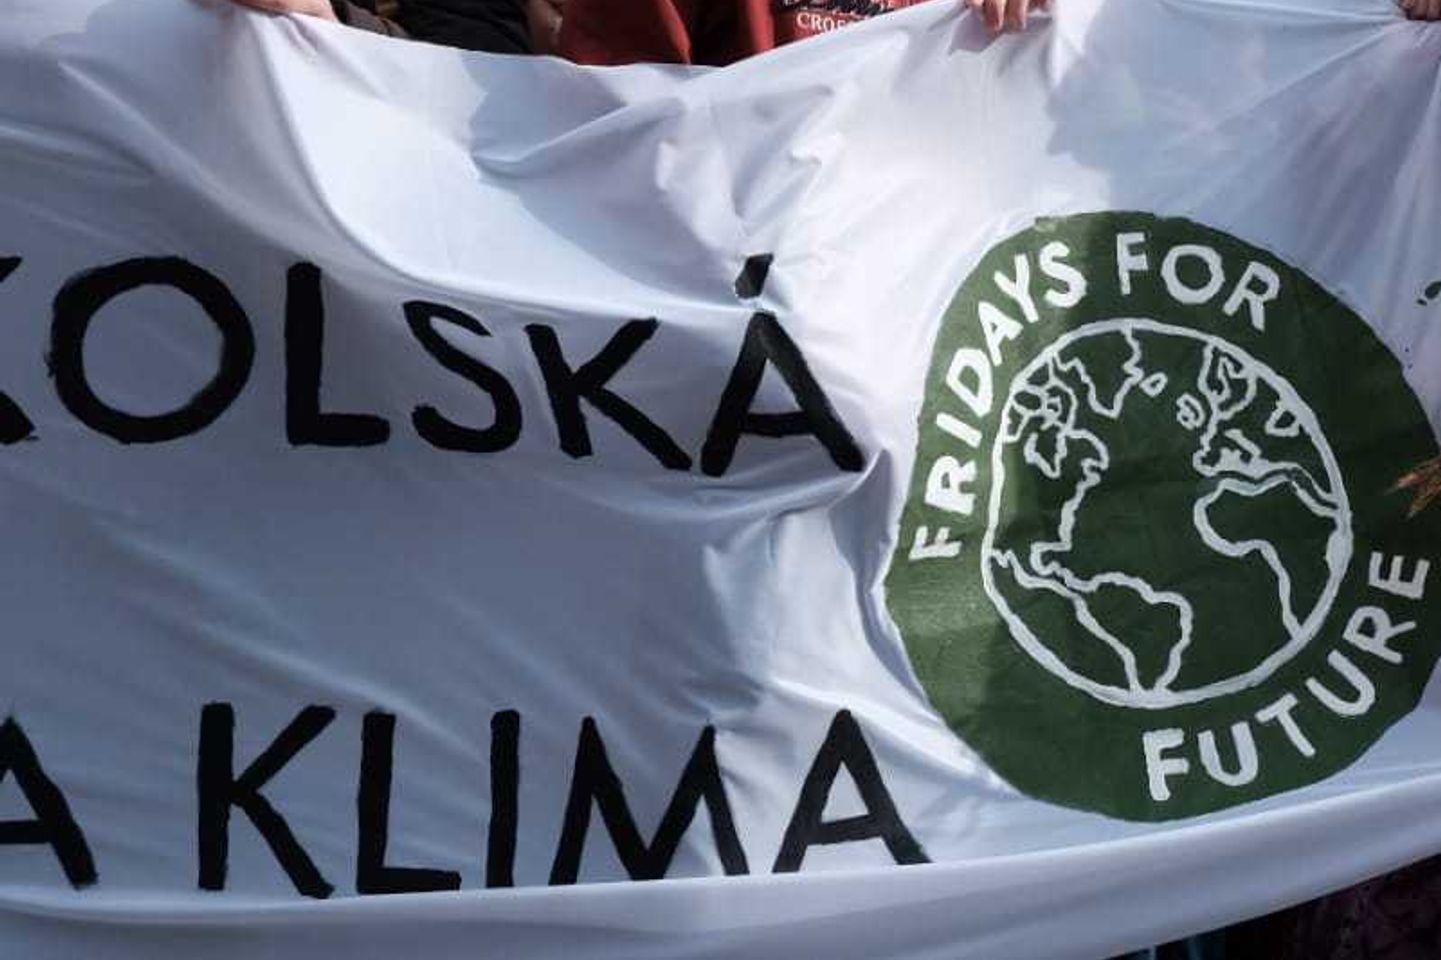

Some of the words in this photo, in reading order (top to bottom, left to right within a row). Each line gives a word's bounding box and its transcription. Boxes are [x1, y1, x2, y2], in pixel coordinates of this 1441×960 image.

[908, 240, 1089, 562] FRIDAYS
[1116, 231, 1282, 332] FOR
[196, 701, 934, 900] KLIMA
[1142, 550, 1431, 803] FUTURE
